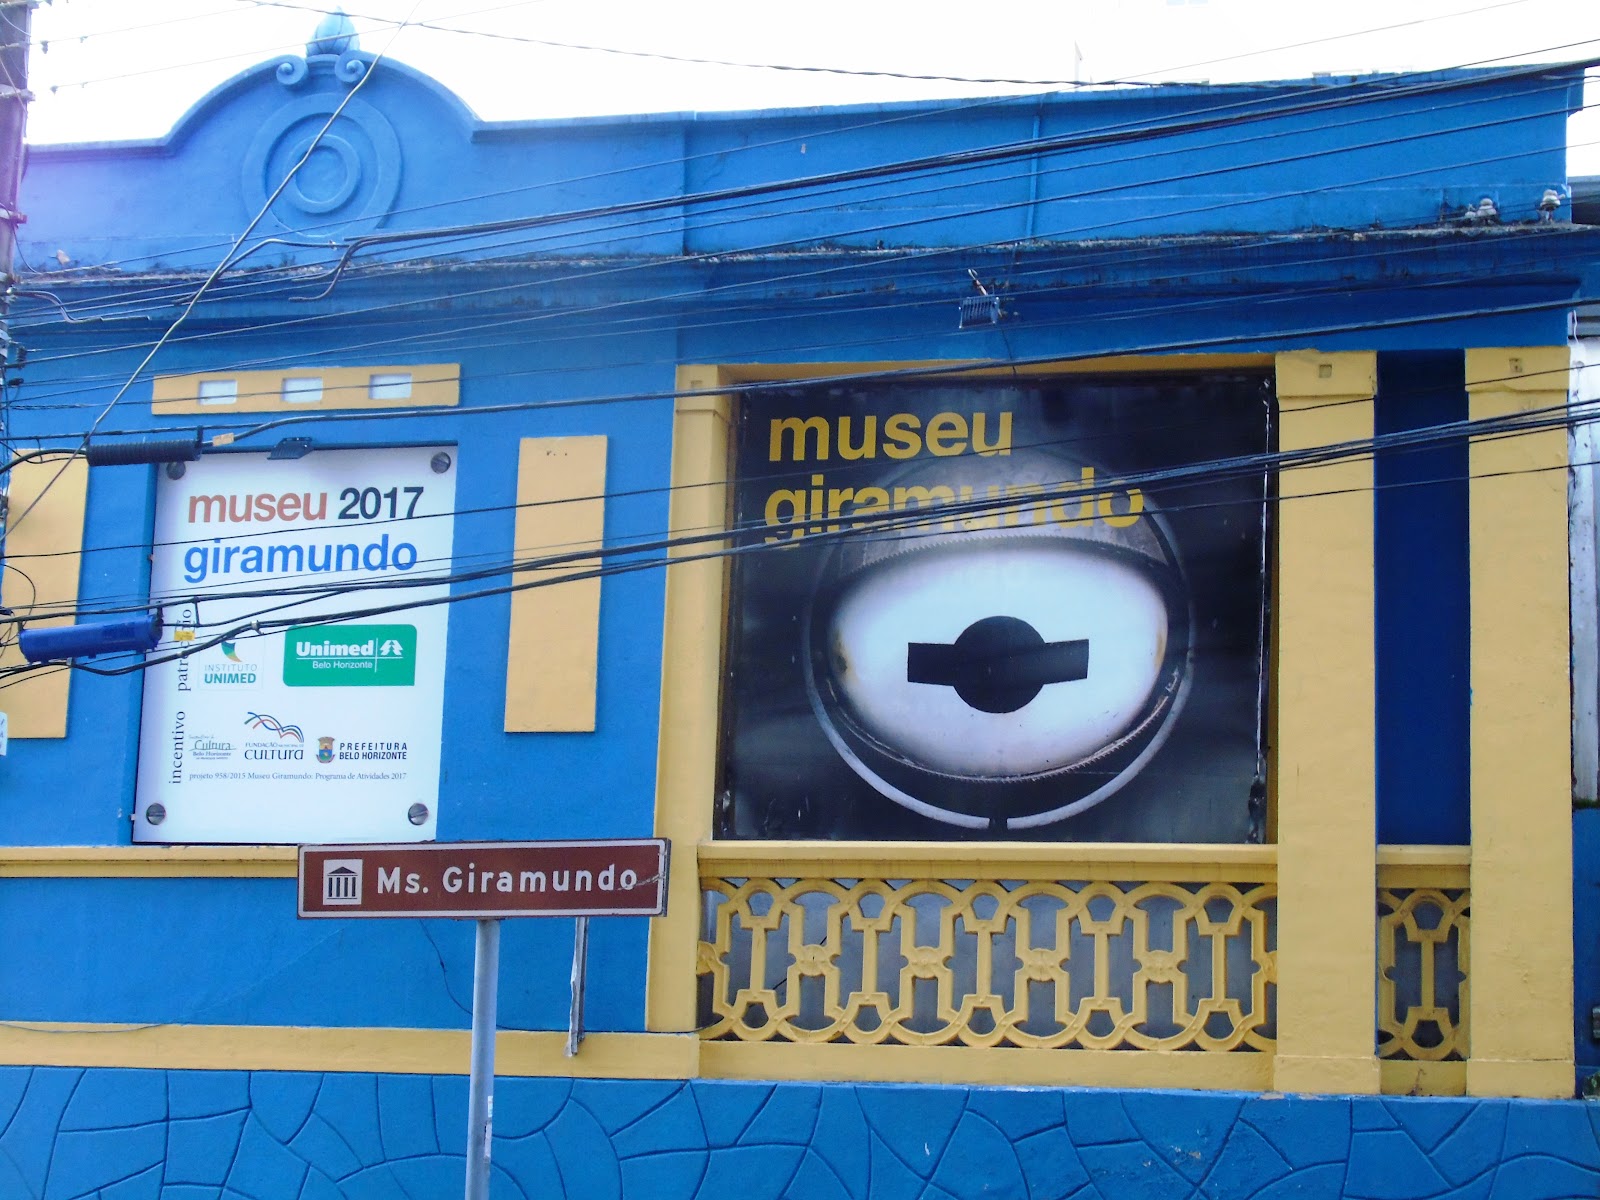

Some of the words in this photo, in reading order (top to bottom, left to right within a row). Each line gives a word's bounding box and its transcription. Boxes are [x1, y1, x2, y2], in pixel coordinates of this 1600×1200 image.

[768, 411, 1013, 462] museu
[188, 492, 328, 523] museu
[338, 486, 424, 520] 2017
[764, 467, 1144, 550] giramundo
[184, 534, 418, 583] giramundo
[296, 640, 374, 656] Unimed
[204, 664, 258, 672] INSTITUTO
[312, 661, 331, 669] Belo
[333, 661, 373, 669] Horizonte
[204, 673, 257, 684] UNIMED
[168, 711, 186, 784] incentivo
[194, 740, 231, 751] Cultura
[339, 742, 408, 751] PREFEITURA
[339, 751, 360, 760] BELO
[361, 751, 407, 760] HORIZONTE
[189, 772, 214, 781] projeto
[247, 772, 270, 780] Museu
[315, 772, 346, 782] Programa
[347, 772, 356, 780] de
[356, 772, 390, 780] Atividades
[391, 772, 407, 780] 2017
[377, 866, 429, 894] Ms.
[442, 862, 637, 894] Giramundo
